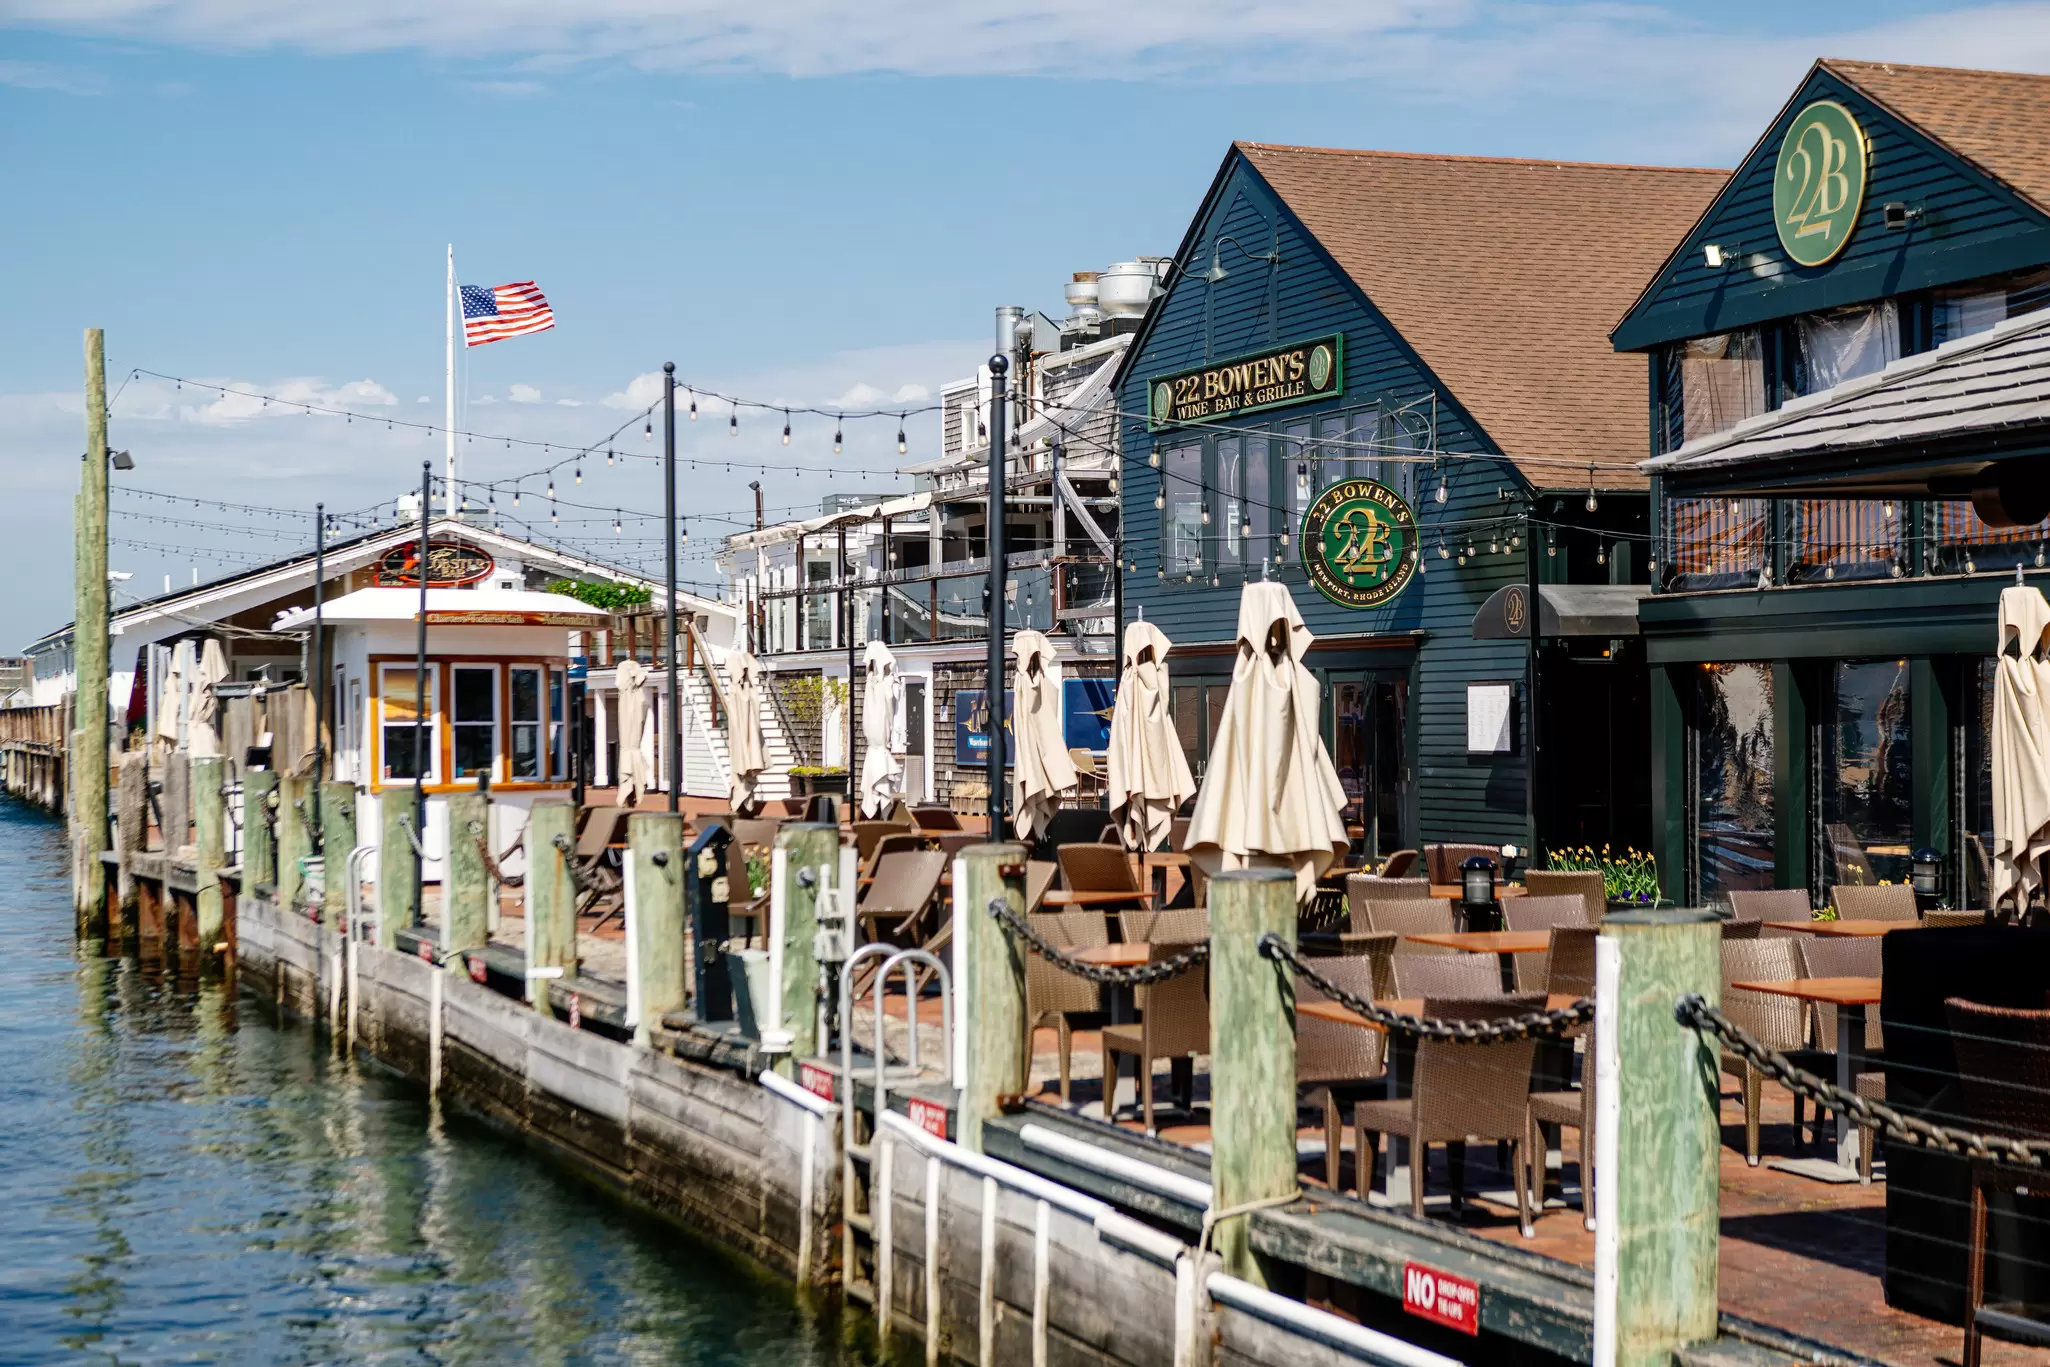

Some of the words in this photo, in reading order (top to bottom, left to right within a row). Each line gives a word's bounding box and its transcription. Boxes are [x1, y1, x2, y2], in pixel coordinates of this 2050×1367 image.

[1175, 376, 1200, 405] 22
[1204, 351, 1304, 399] BOWEN'S
[1177, 401, 1208, 420] WINE
[1215, 395, 1240, 412] BAR
[1244, 392, 1253, 407] &
[1256, 381, 1304, 404] GRILLE
[1331, 484, 1409, 522] BOWEN'S
[1353, 588, 1384, 601] RHODE
[1386, 563, 1409, 593] ISLAND
[1407, 1268, 1435, 1310] NO
